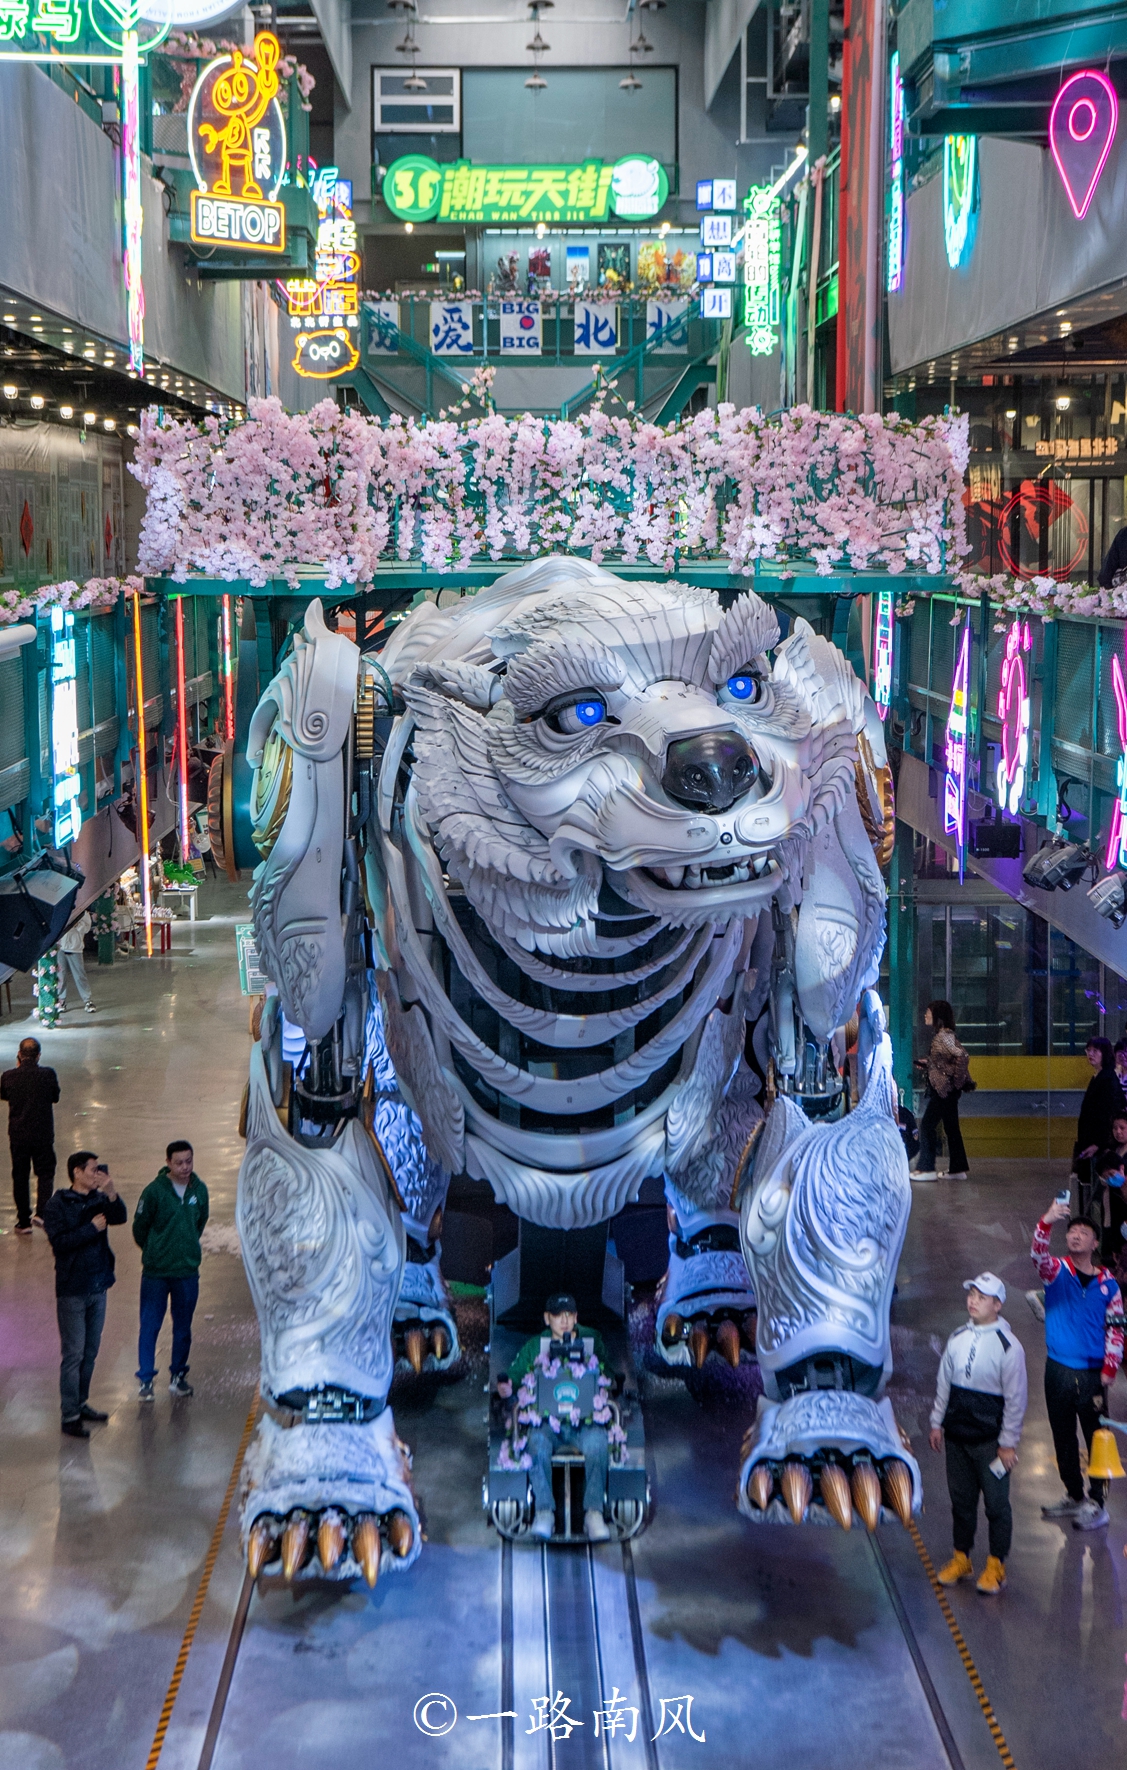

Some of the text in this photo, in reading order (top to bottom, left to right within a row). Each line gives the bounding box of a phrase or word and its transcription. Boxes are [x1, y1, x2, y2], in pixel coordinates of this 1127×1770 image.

[441, 165, 613, 217] 潮玩天街
[198, 198, 281, 245] BETOP
[450, 211, 484, 221] CHAO
[492, 211, 518, 221] WAN
[432, 306, 473, 352] 爱
[502, 302, 540, 314] BIG
[574, 307, 617, 350] 北
[502, 337, 540, 349] BIG
